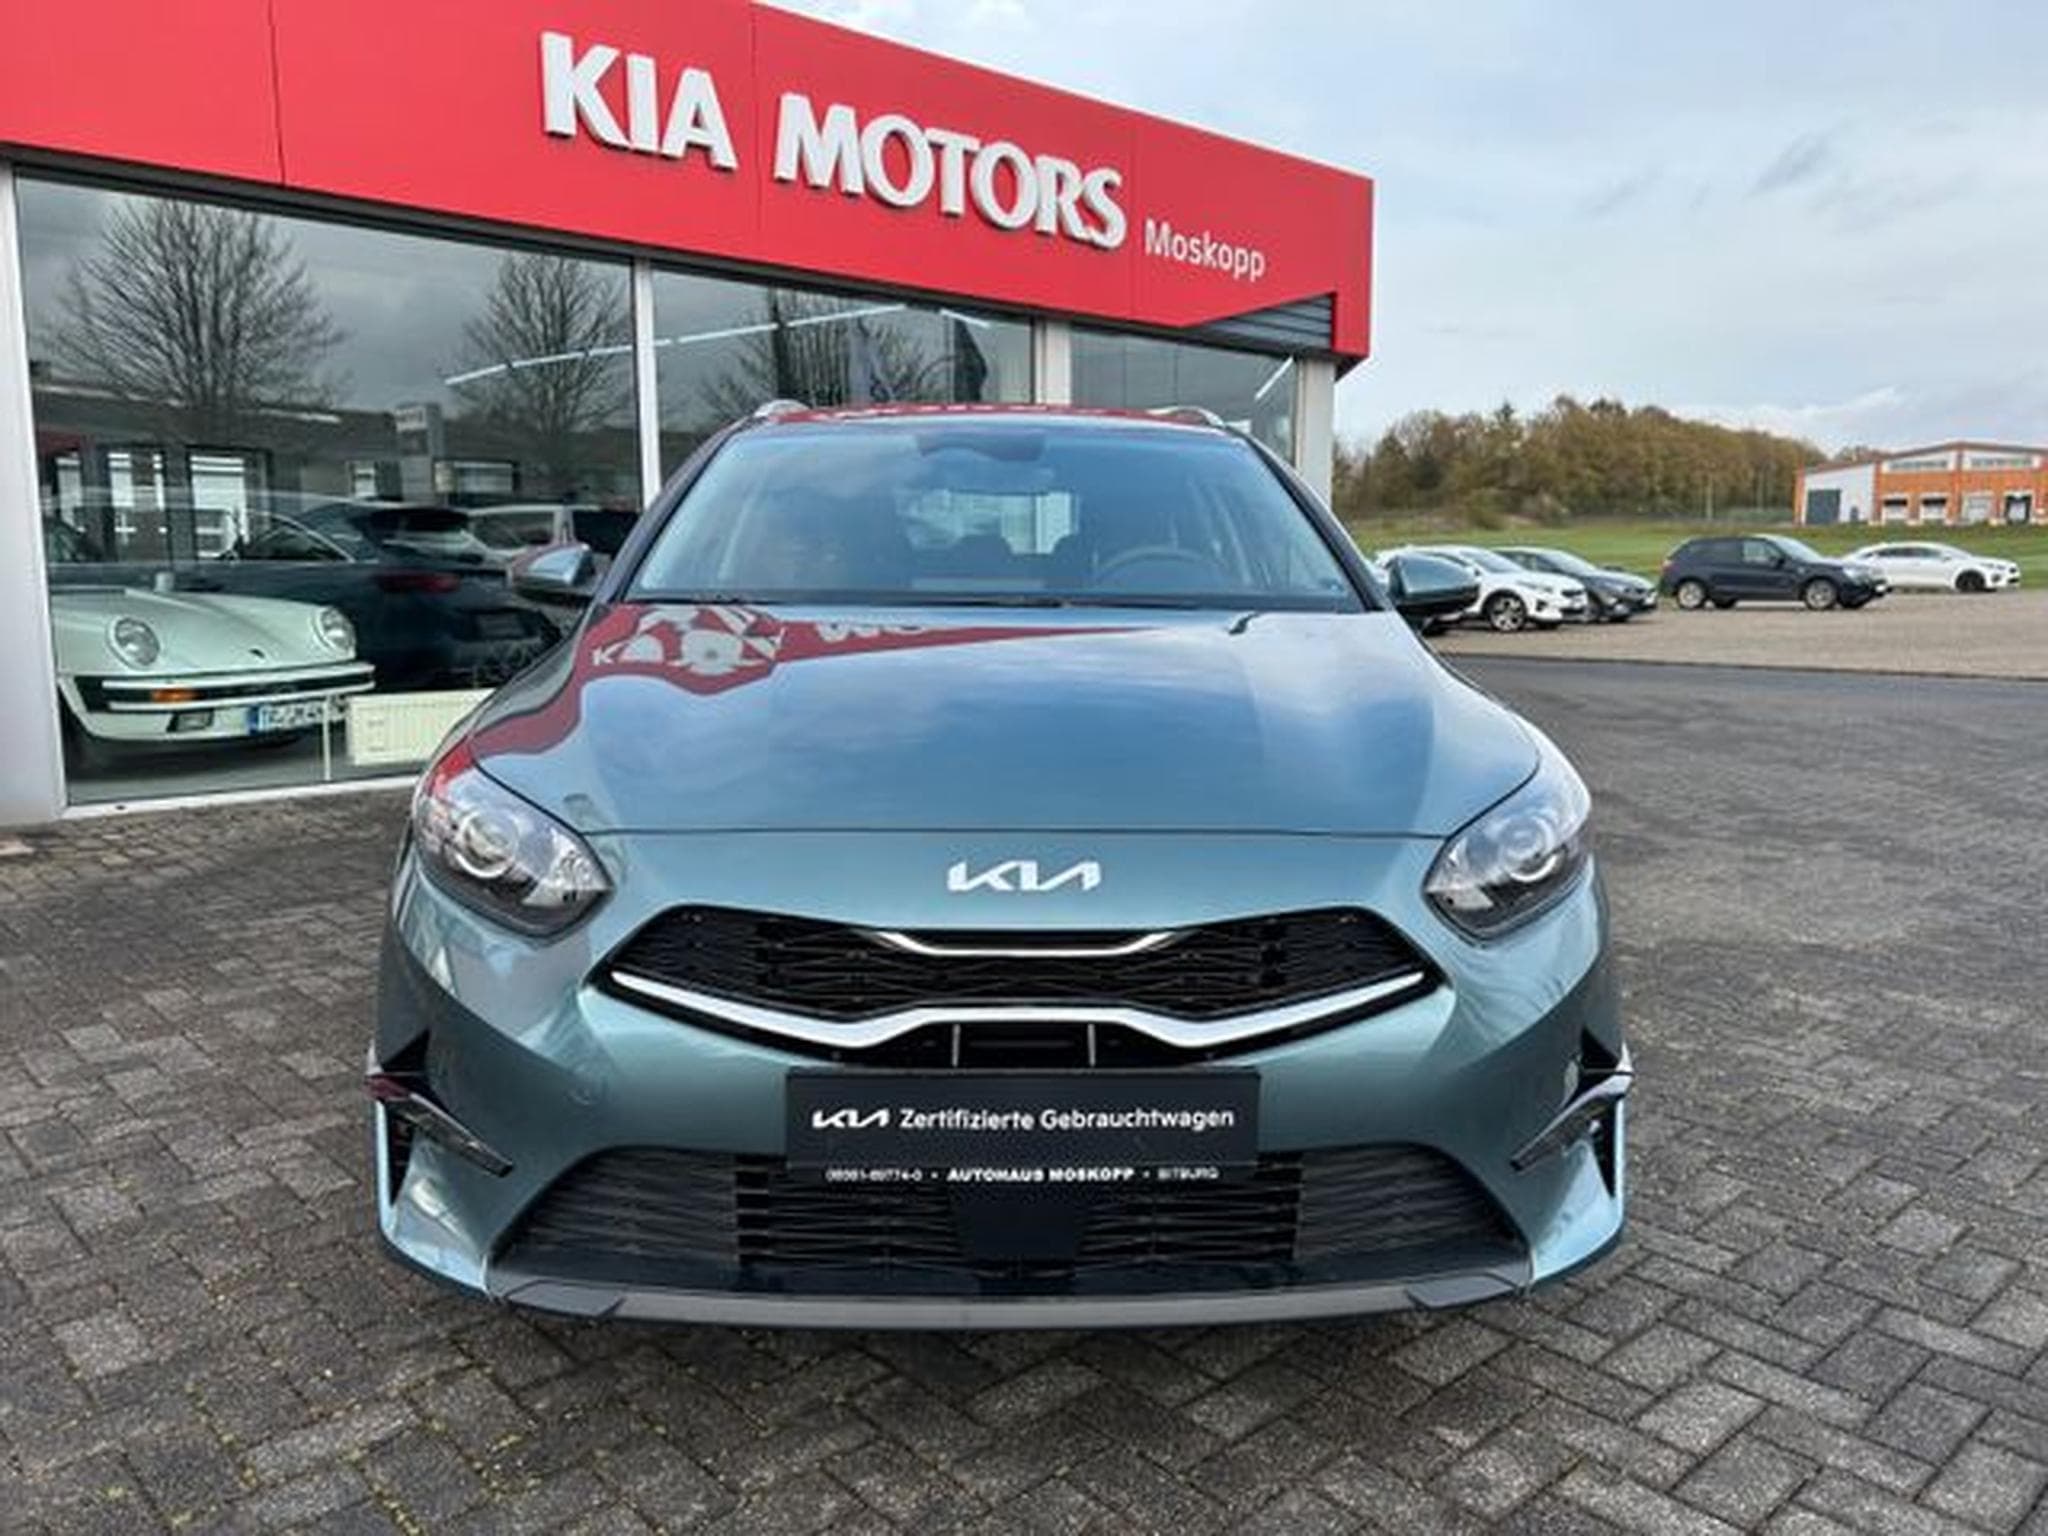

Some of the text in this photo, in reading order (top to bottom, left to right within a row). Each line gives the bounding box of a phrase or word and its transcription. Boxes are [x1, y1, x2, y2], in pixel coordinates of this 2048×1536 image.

[540, 33, 1266, 281] KIA MOTORS Moskopp
[948, 861, 1101, 891] KIA
[813, 1108, 1235, 1132] KIA Zertifizierte Gebrauchtwagen
[946, 1167, 1044, 1183] AUTOHAUS
[1049, 1167, 1136, 1182] MOSKOPP
